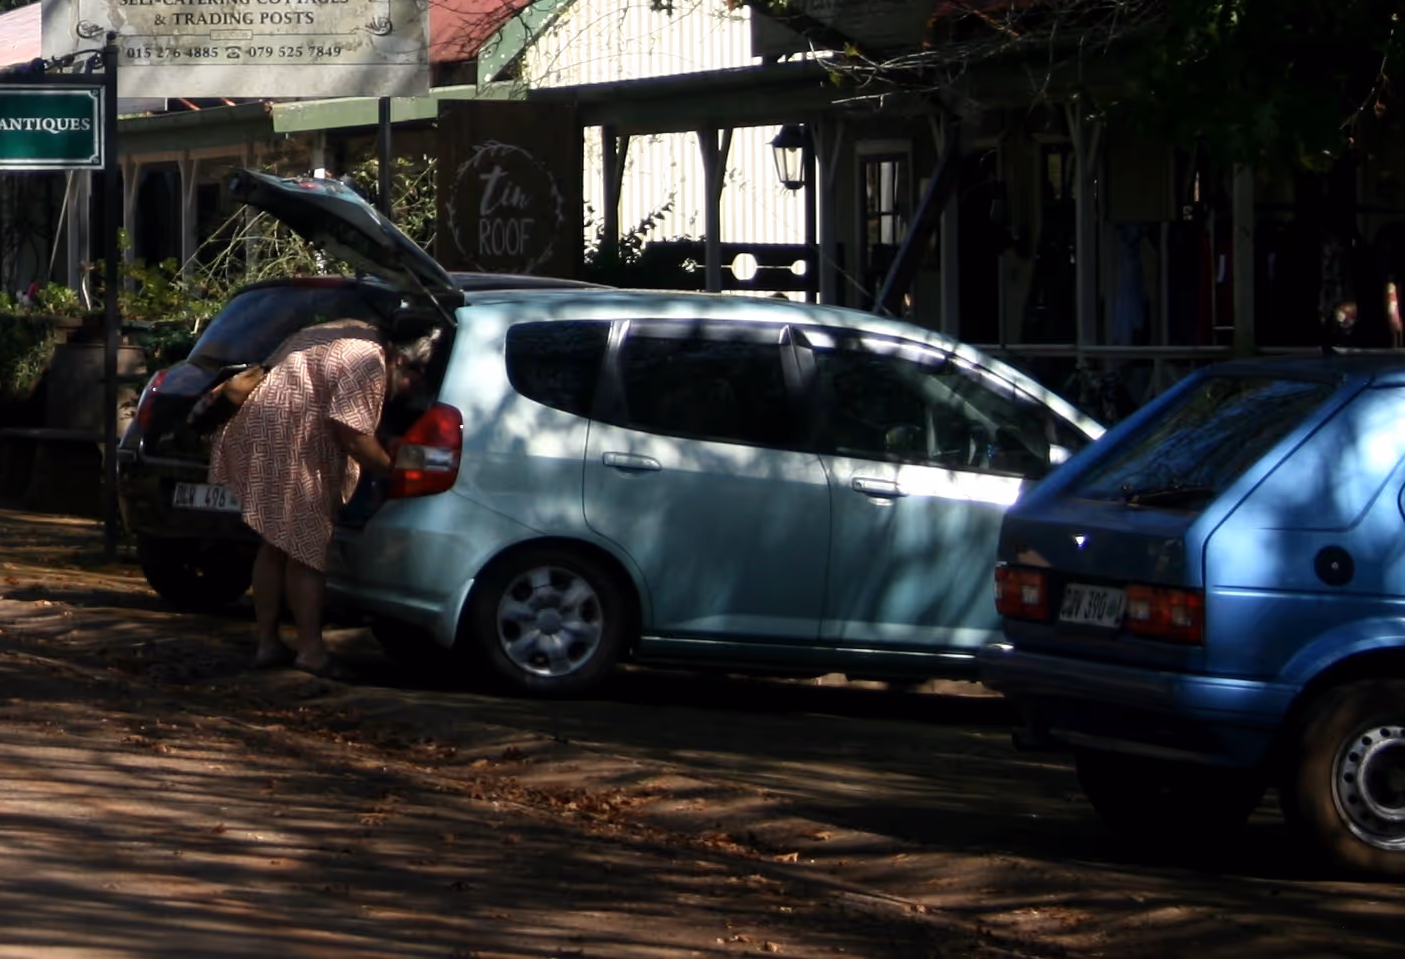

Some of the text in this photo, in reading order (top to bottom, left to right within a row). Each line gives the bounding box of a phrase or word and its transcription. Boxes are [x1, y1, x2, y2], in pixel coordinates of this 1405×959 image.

[154, 10, 315, 26] & TRADING POSTS
[126, 45, 342, 59] 015 276 4885 079 525 7849
[479, 217, 535, 256] ROOF
